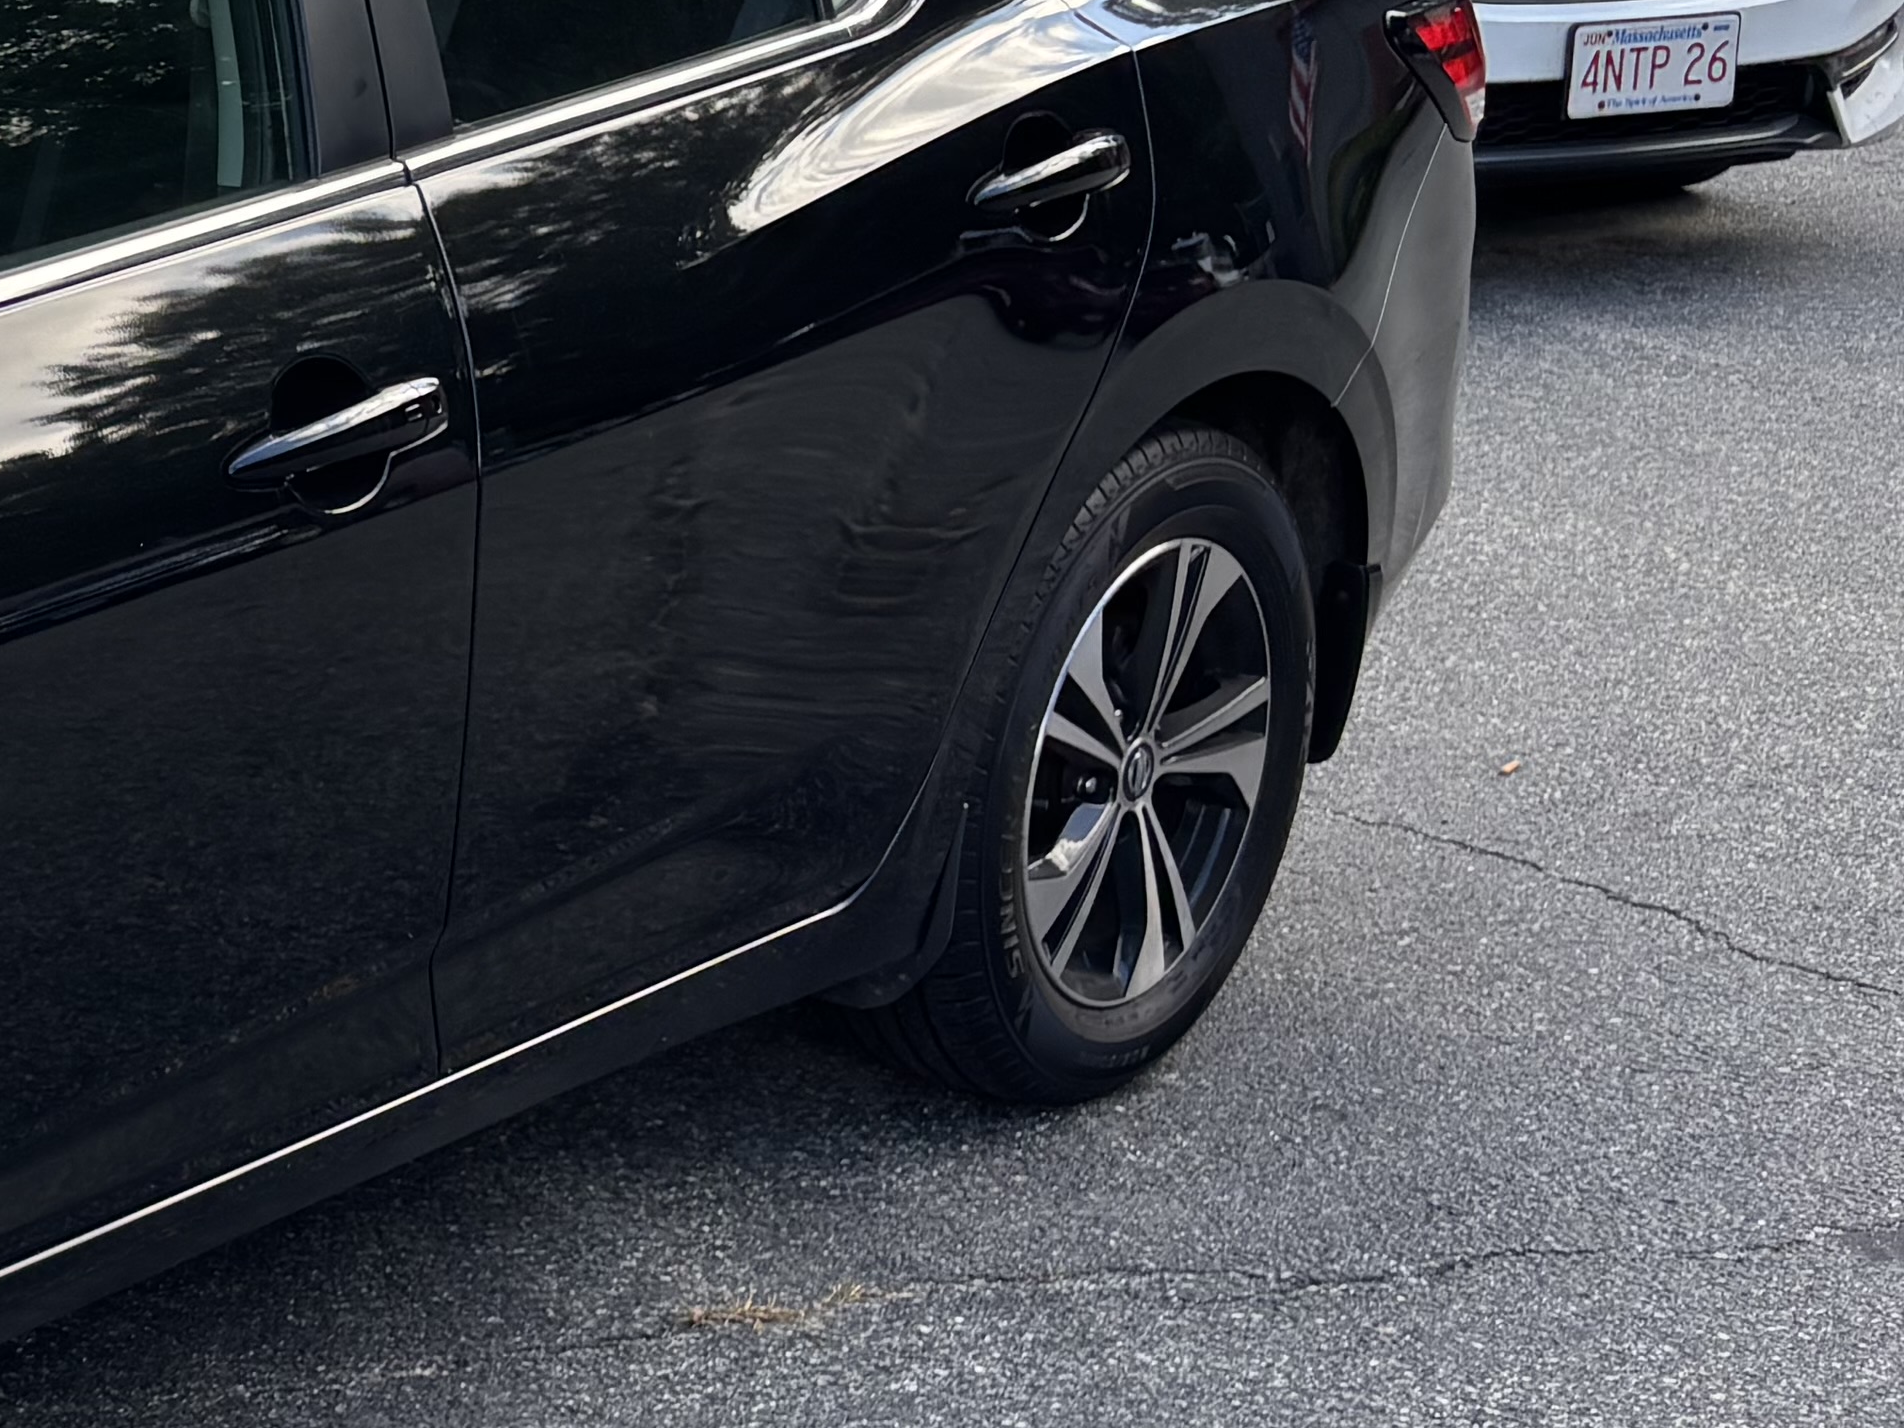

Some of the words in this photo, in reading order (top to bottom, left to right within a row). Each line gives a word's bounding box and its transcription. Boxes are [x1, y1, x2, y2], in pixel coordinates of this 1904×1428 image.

[1612, 25, 1702, 46] Massachusetts
[1581, 45, 1671, 94] 4NTP
[1683, 40, 1730, 87] 26
